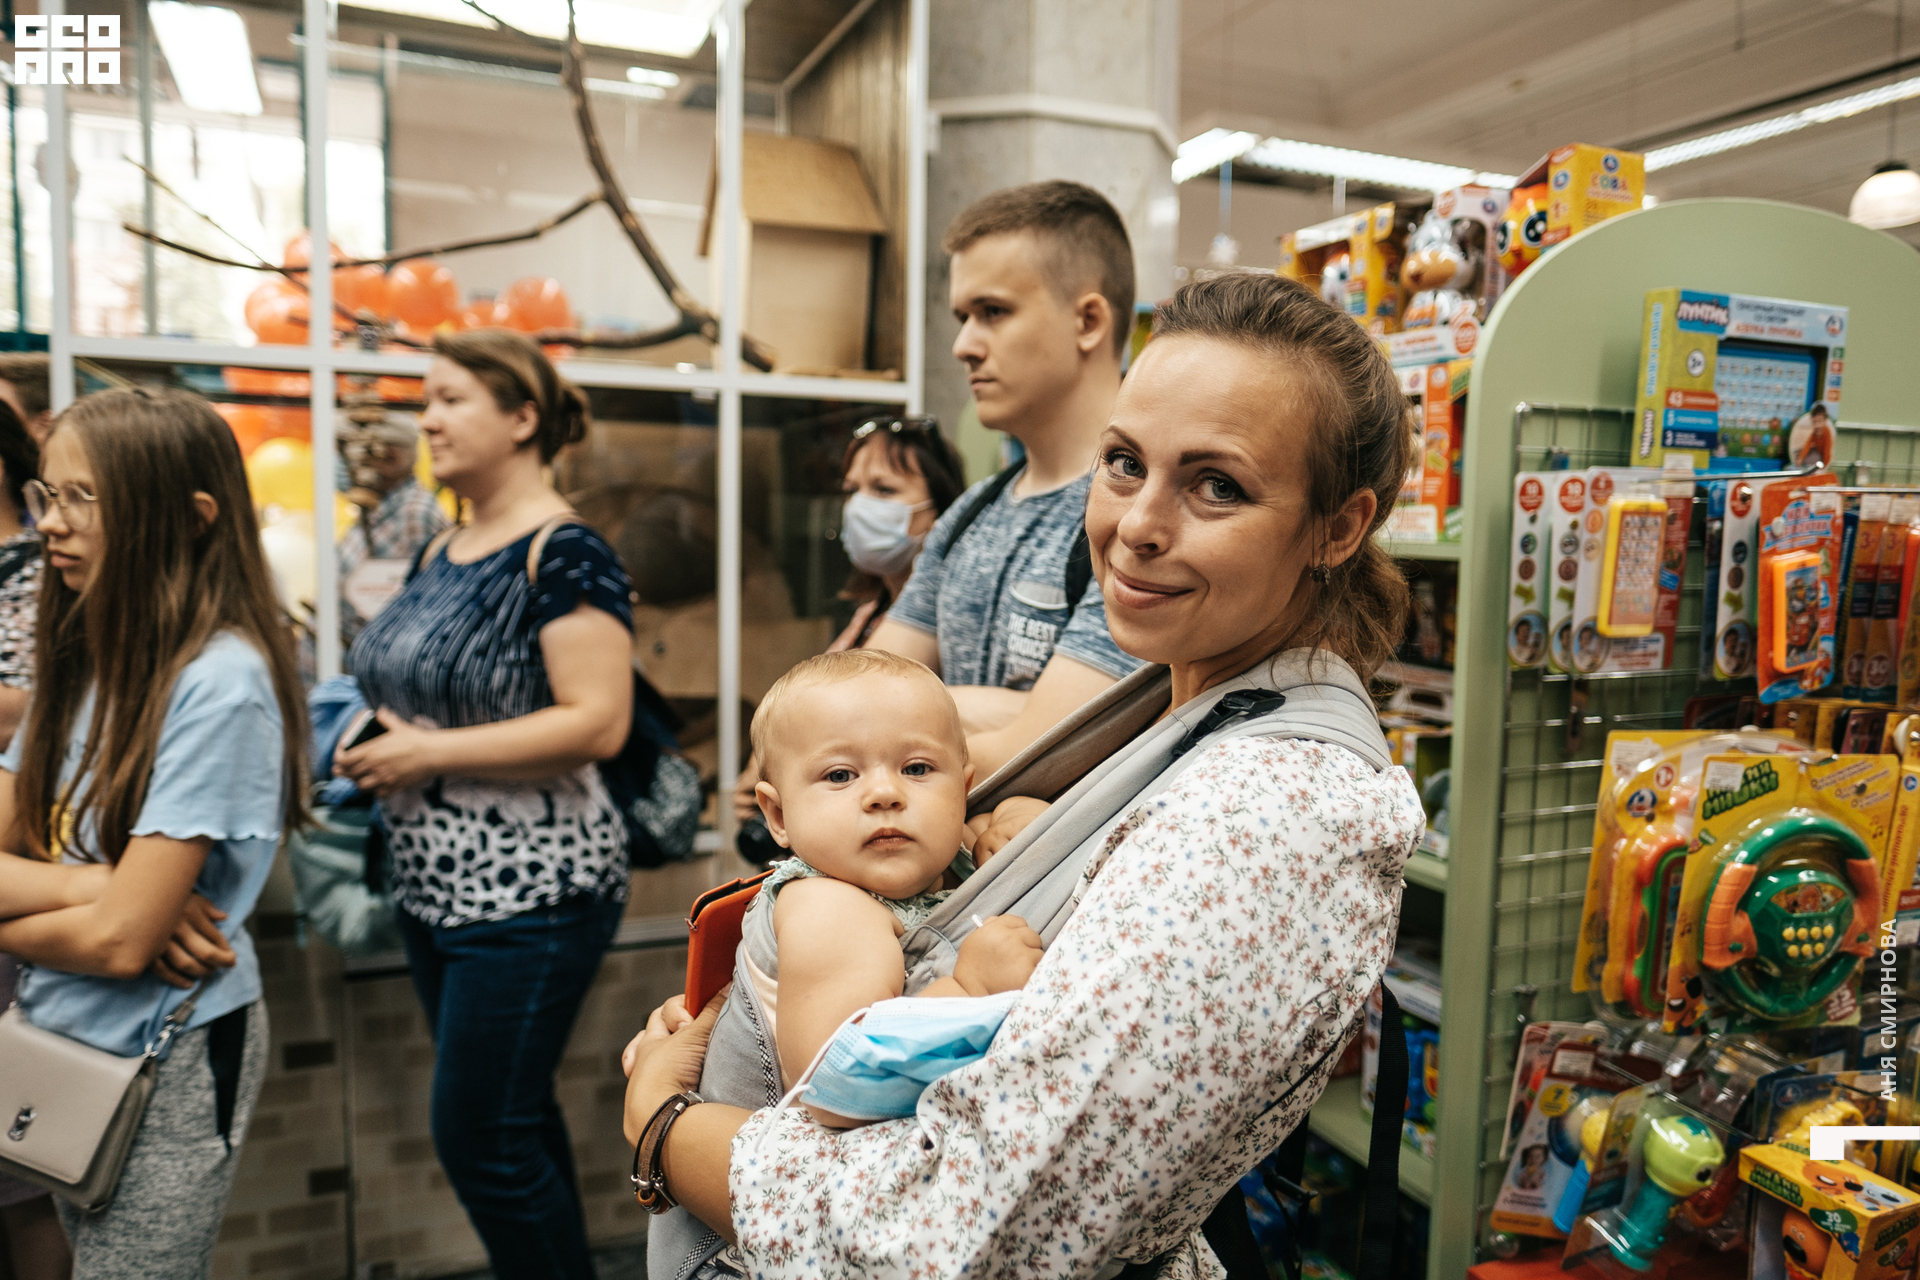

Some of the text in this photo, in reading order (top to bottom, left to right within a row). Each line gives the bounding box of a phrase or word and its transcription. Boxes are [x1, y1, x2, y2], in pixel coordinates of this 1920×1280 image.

[1677, 299, 1730, 327] ЛУНТИК
[1008, 612, 1057, 642] THE BEST
[1007, 633, 1049, 660] CHOICE
[1703, 771, 1779, 820] МИШКИ
[1826, 1211, 1841, 1223] 30
